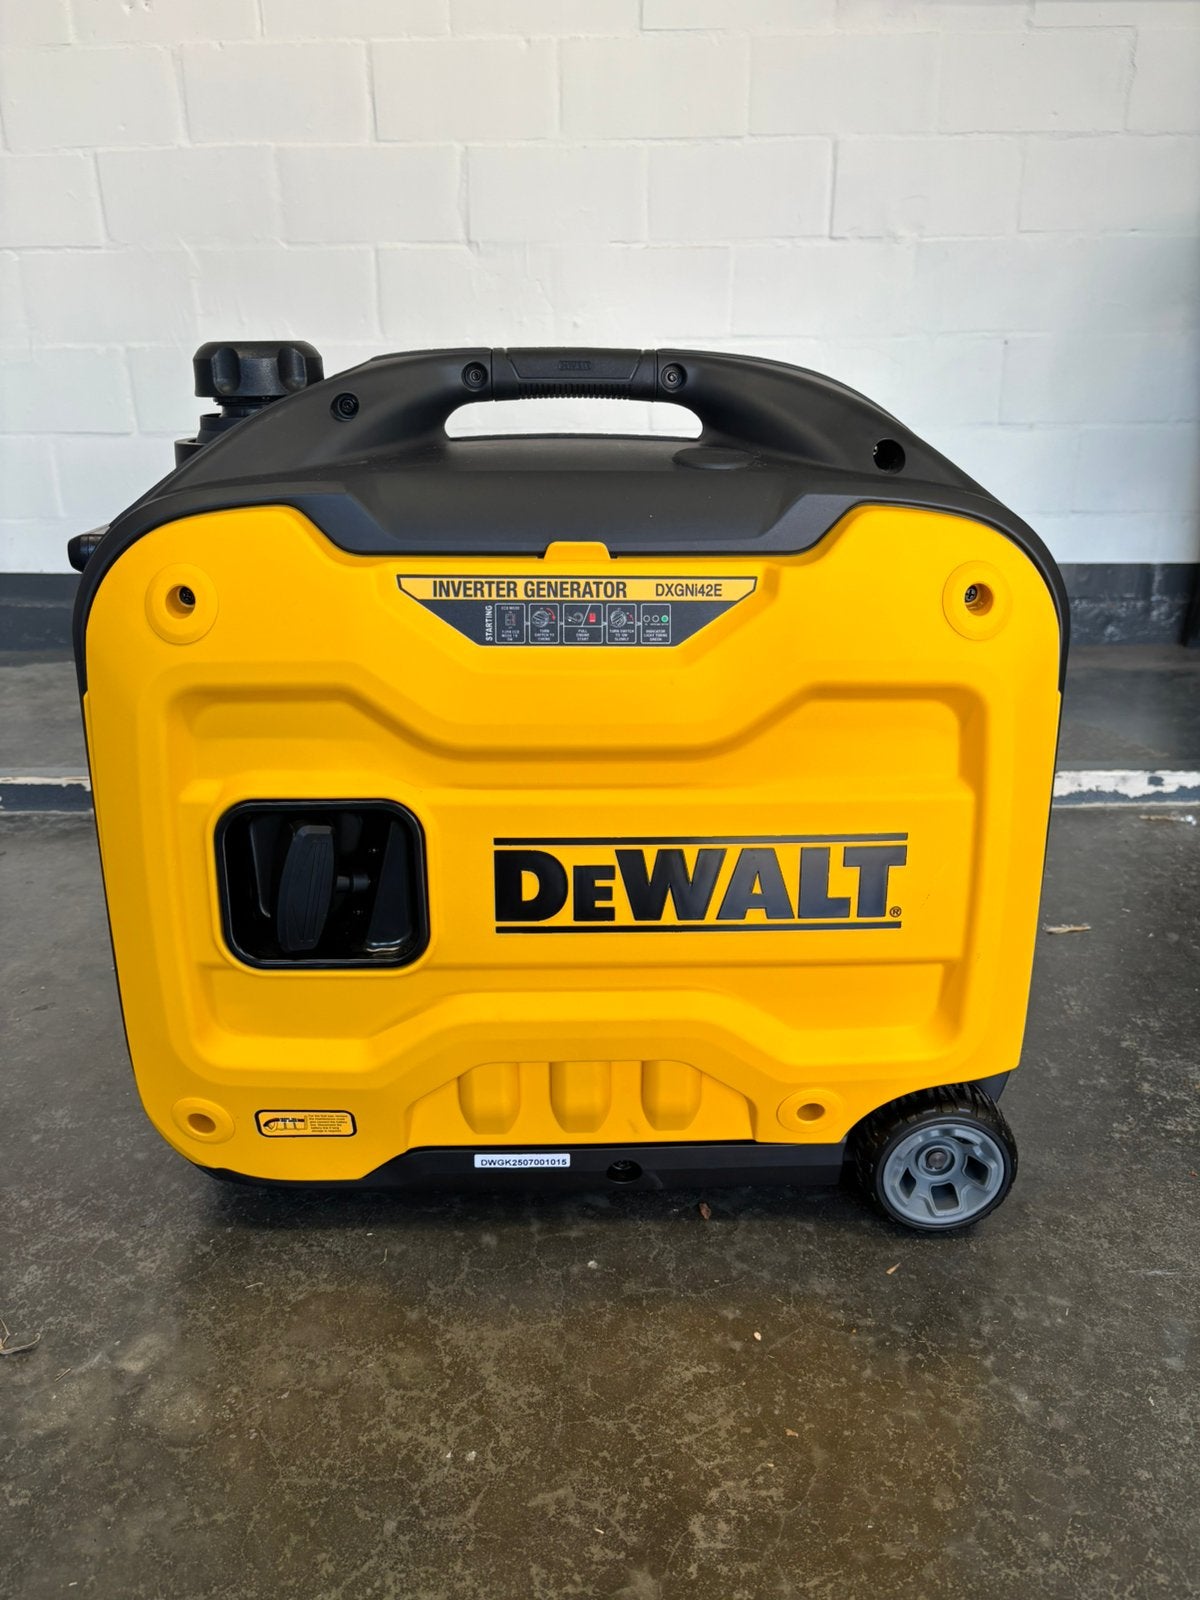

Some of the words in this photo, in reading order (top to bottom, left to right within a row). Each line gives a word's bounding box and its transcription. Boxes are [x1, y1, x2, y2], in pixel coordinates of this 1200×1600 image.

[432, 580, 518, 598] INVERTER
[523, 580, 628, 599] GENERATOR
[655, 583, 722, 598] DXGNi42E
[485, 604, 494, 642] STARTING
[493, 844, 908, 922] DEWALT
[480, 1158, 568, 1166] DWGK2507001015
